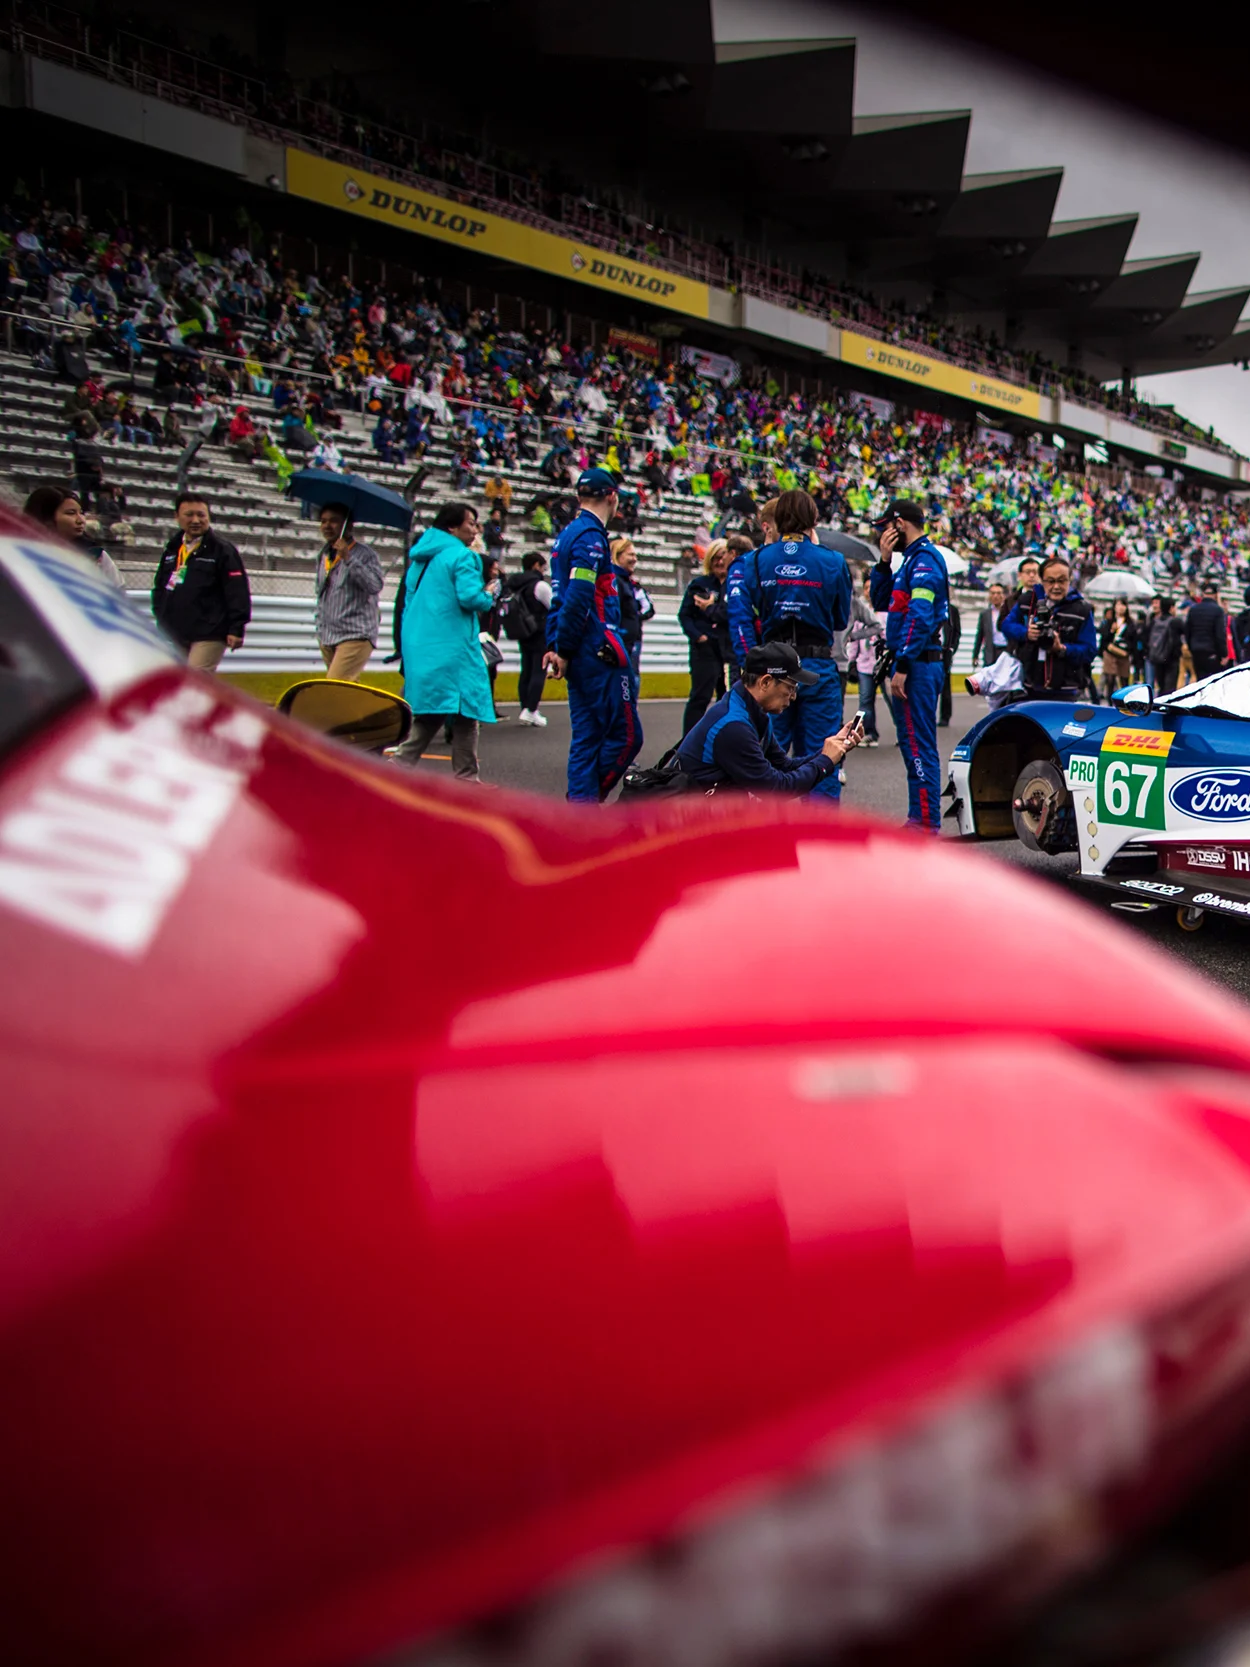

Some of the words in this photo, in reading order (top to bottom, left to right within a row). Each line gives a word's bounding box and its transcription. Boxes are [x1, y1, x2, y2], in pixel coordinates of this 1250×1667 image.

[368, 188, 487, 239] DUNLOP
[588, 258, 677, 298] DUNLOP
[877, 350, 931, 377] DUNLOP
[979, 383, 1024, 405] DUNLOP
[780, 565, 801, 576] Ford
[1113, 733, 1162, 750] DHL
[1069, 759, 1096, 783] PRO
[1103, 760, 1159, 820] 67
